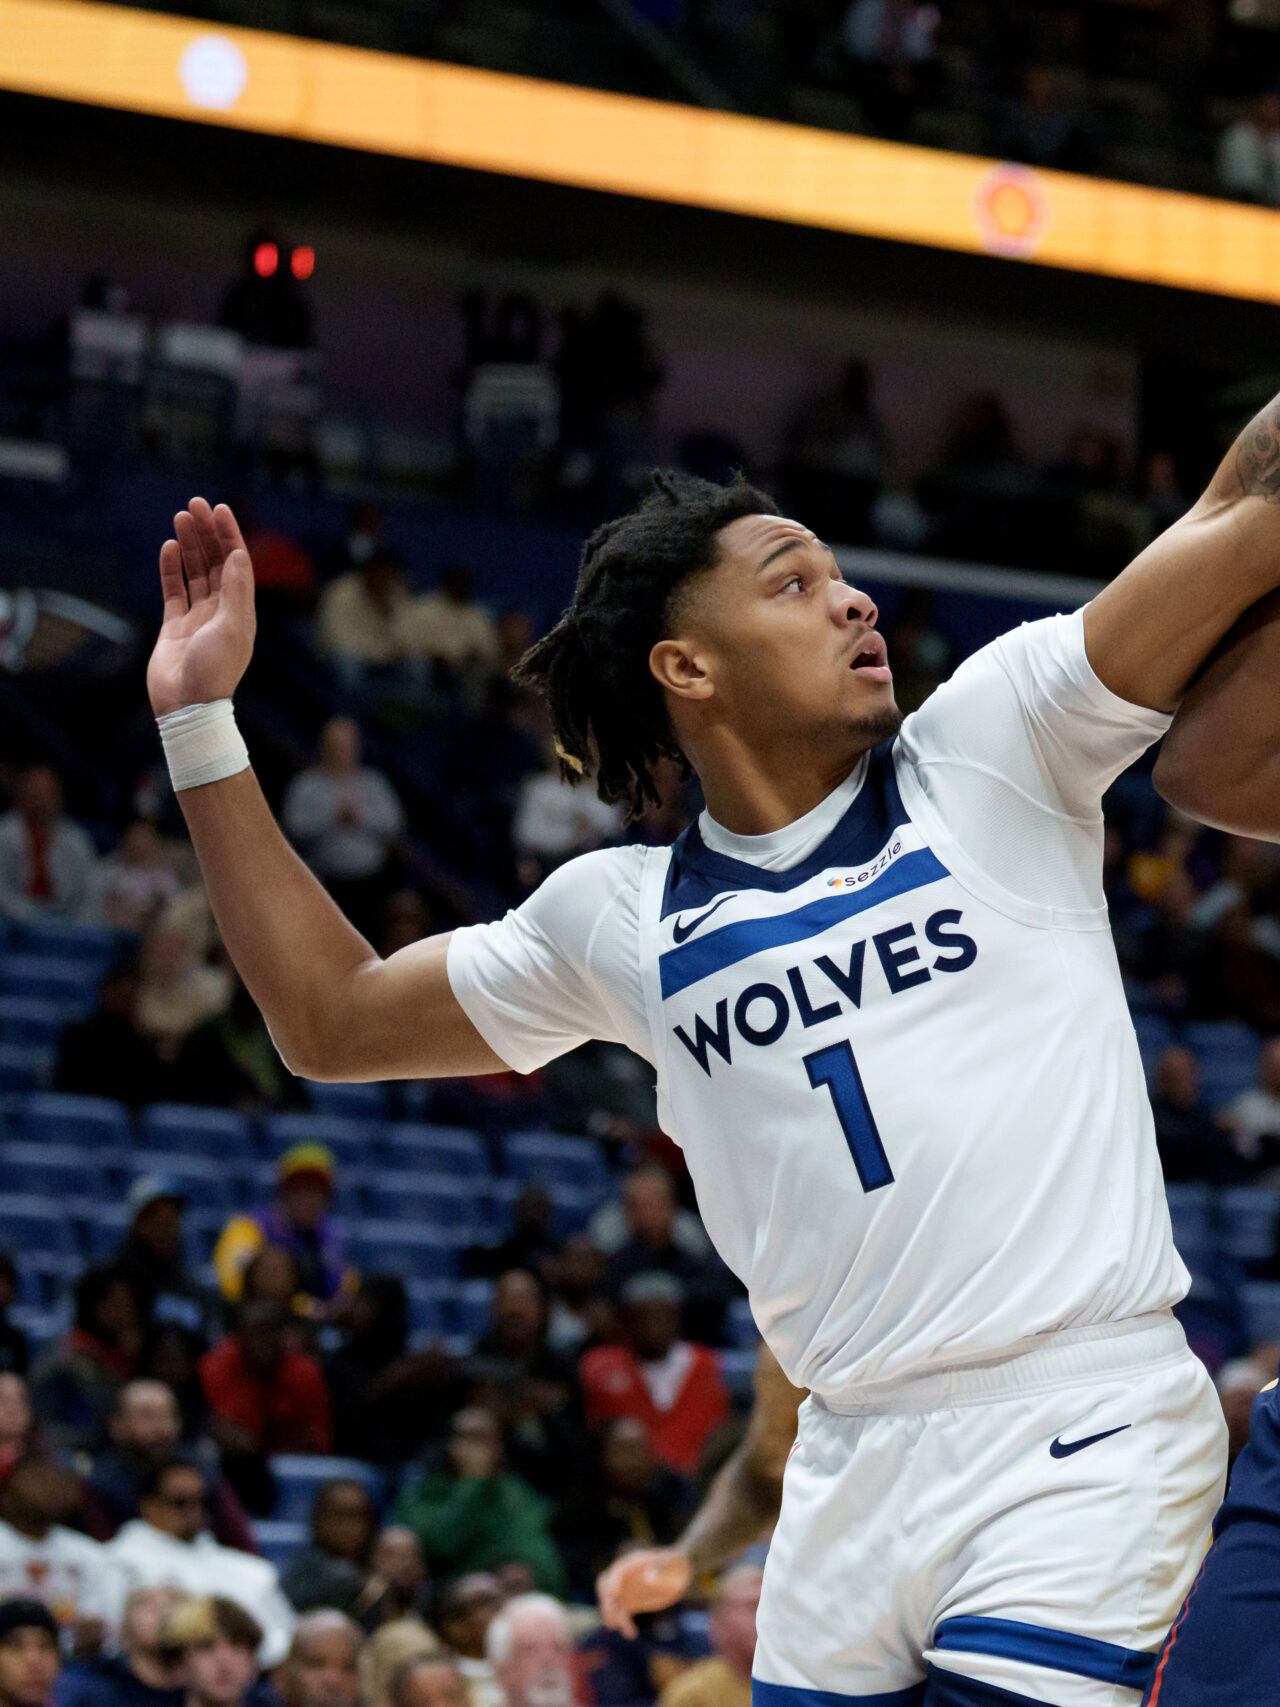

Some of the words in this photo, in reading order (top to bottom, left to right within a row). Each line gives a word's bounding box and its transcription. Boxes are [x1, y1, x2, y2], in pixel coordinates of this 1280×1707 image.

[844, 842, 901, 887] sezzle
[672, 908, 978, 1078] WOLVES
[802, 1038, 895, 1193] 1
